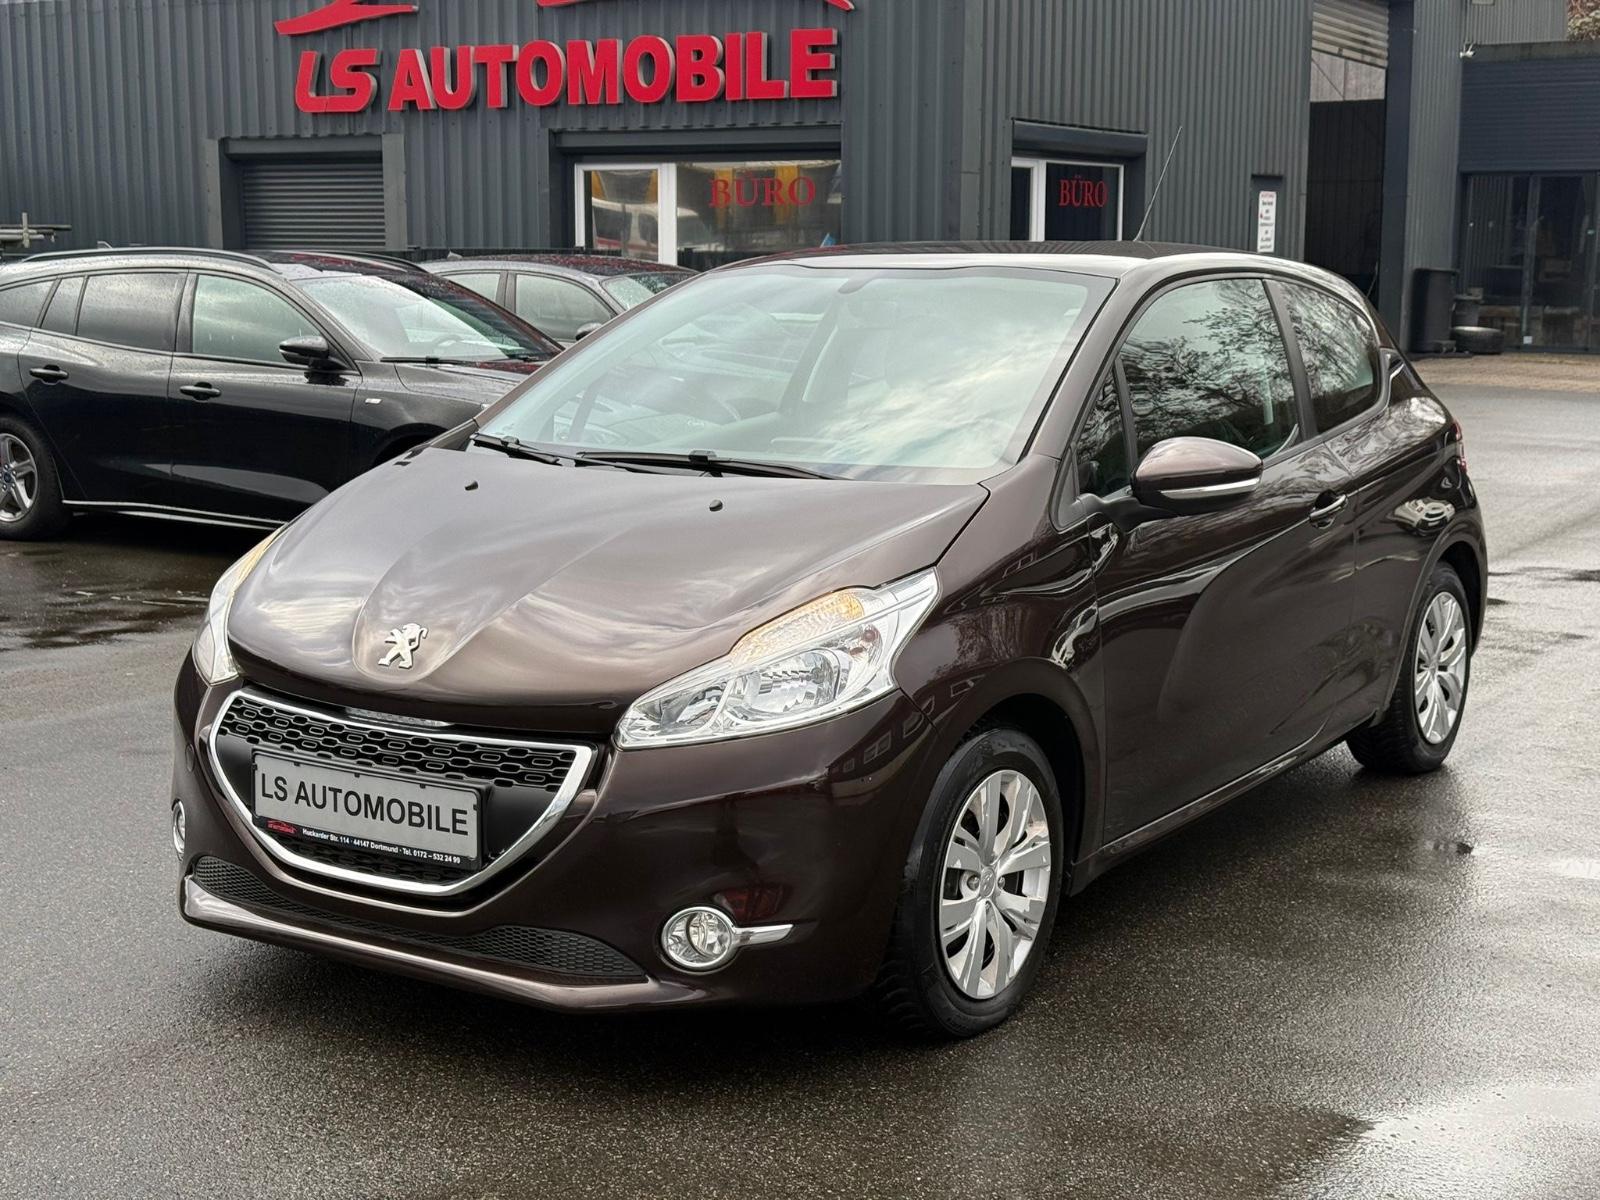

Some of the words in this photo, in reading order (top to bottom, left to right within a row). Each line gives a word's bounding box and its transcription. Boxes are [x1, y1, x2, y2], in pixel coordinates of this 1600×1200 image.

[295, 48, 380, 113] LS
[388, 27, 839, 112] AUTOMOBILE
[708, 172, 817, 208] BÜRO
[1059, 174, 1108, 208] BÜRO
[261, 773, 288, 802] LS
[294, 781, 469, 836] AUTOMOBILE
[302, 828, 329, 839] Huckarder
[329, 833, 339, 842] Str.
[340, 836, 350, 844] 114
[353, 839, 370, 848] 44147
[370, 841, 398, 852] Dortmund
[402, 847, 413, 856] Tel.
[413, 850, 428, 859] 0172
[432, 853, 443, 861] 532
